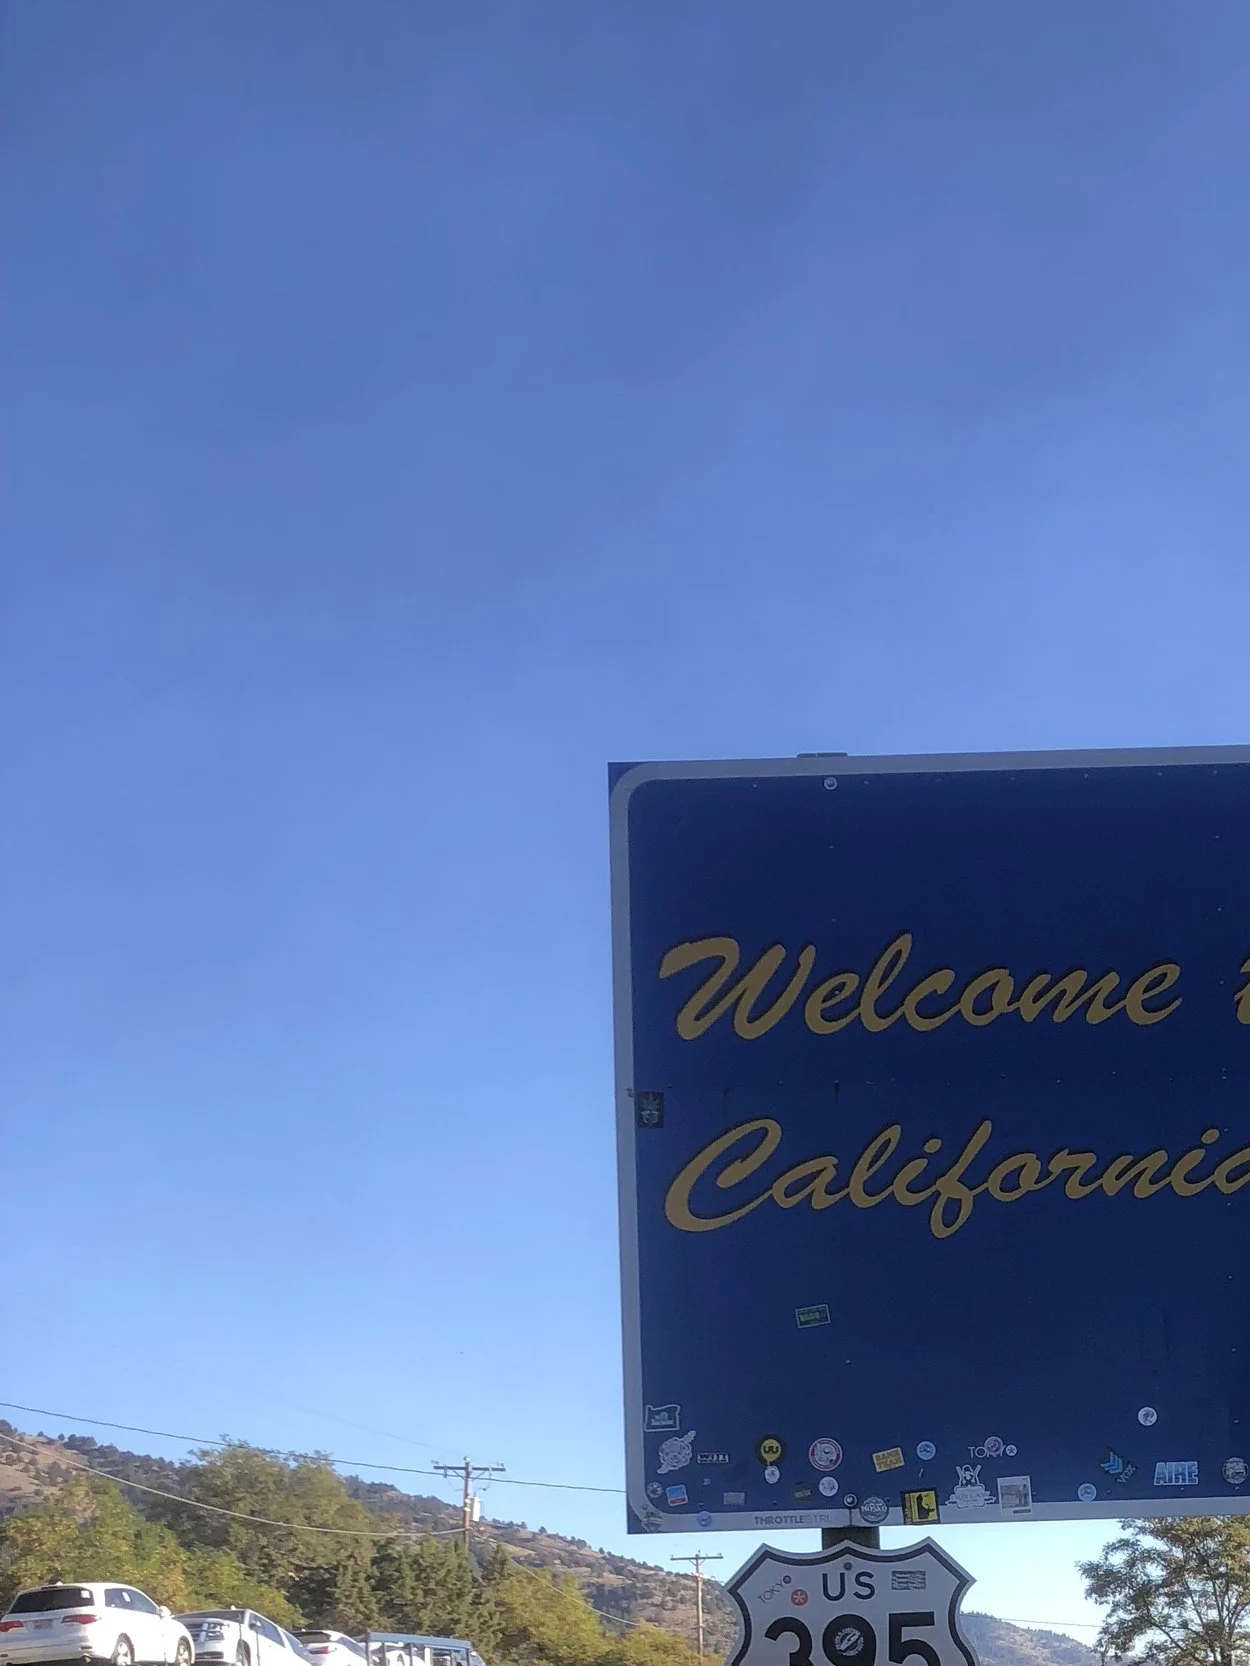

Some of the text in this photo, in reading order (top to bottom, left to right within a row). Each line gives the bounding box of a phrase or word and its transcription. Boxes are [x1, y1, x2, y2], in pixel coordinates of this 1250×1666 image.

[660, 933, 1182, 1041] Welcome
[1117, 1463, 1137, 1484] VOX
[822, 1571, 876, 1601] US
